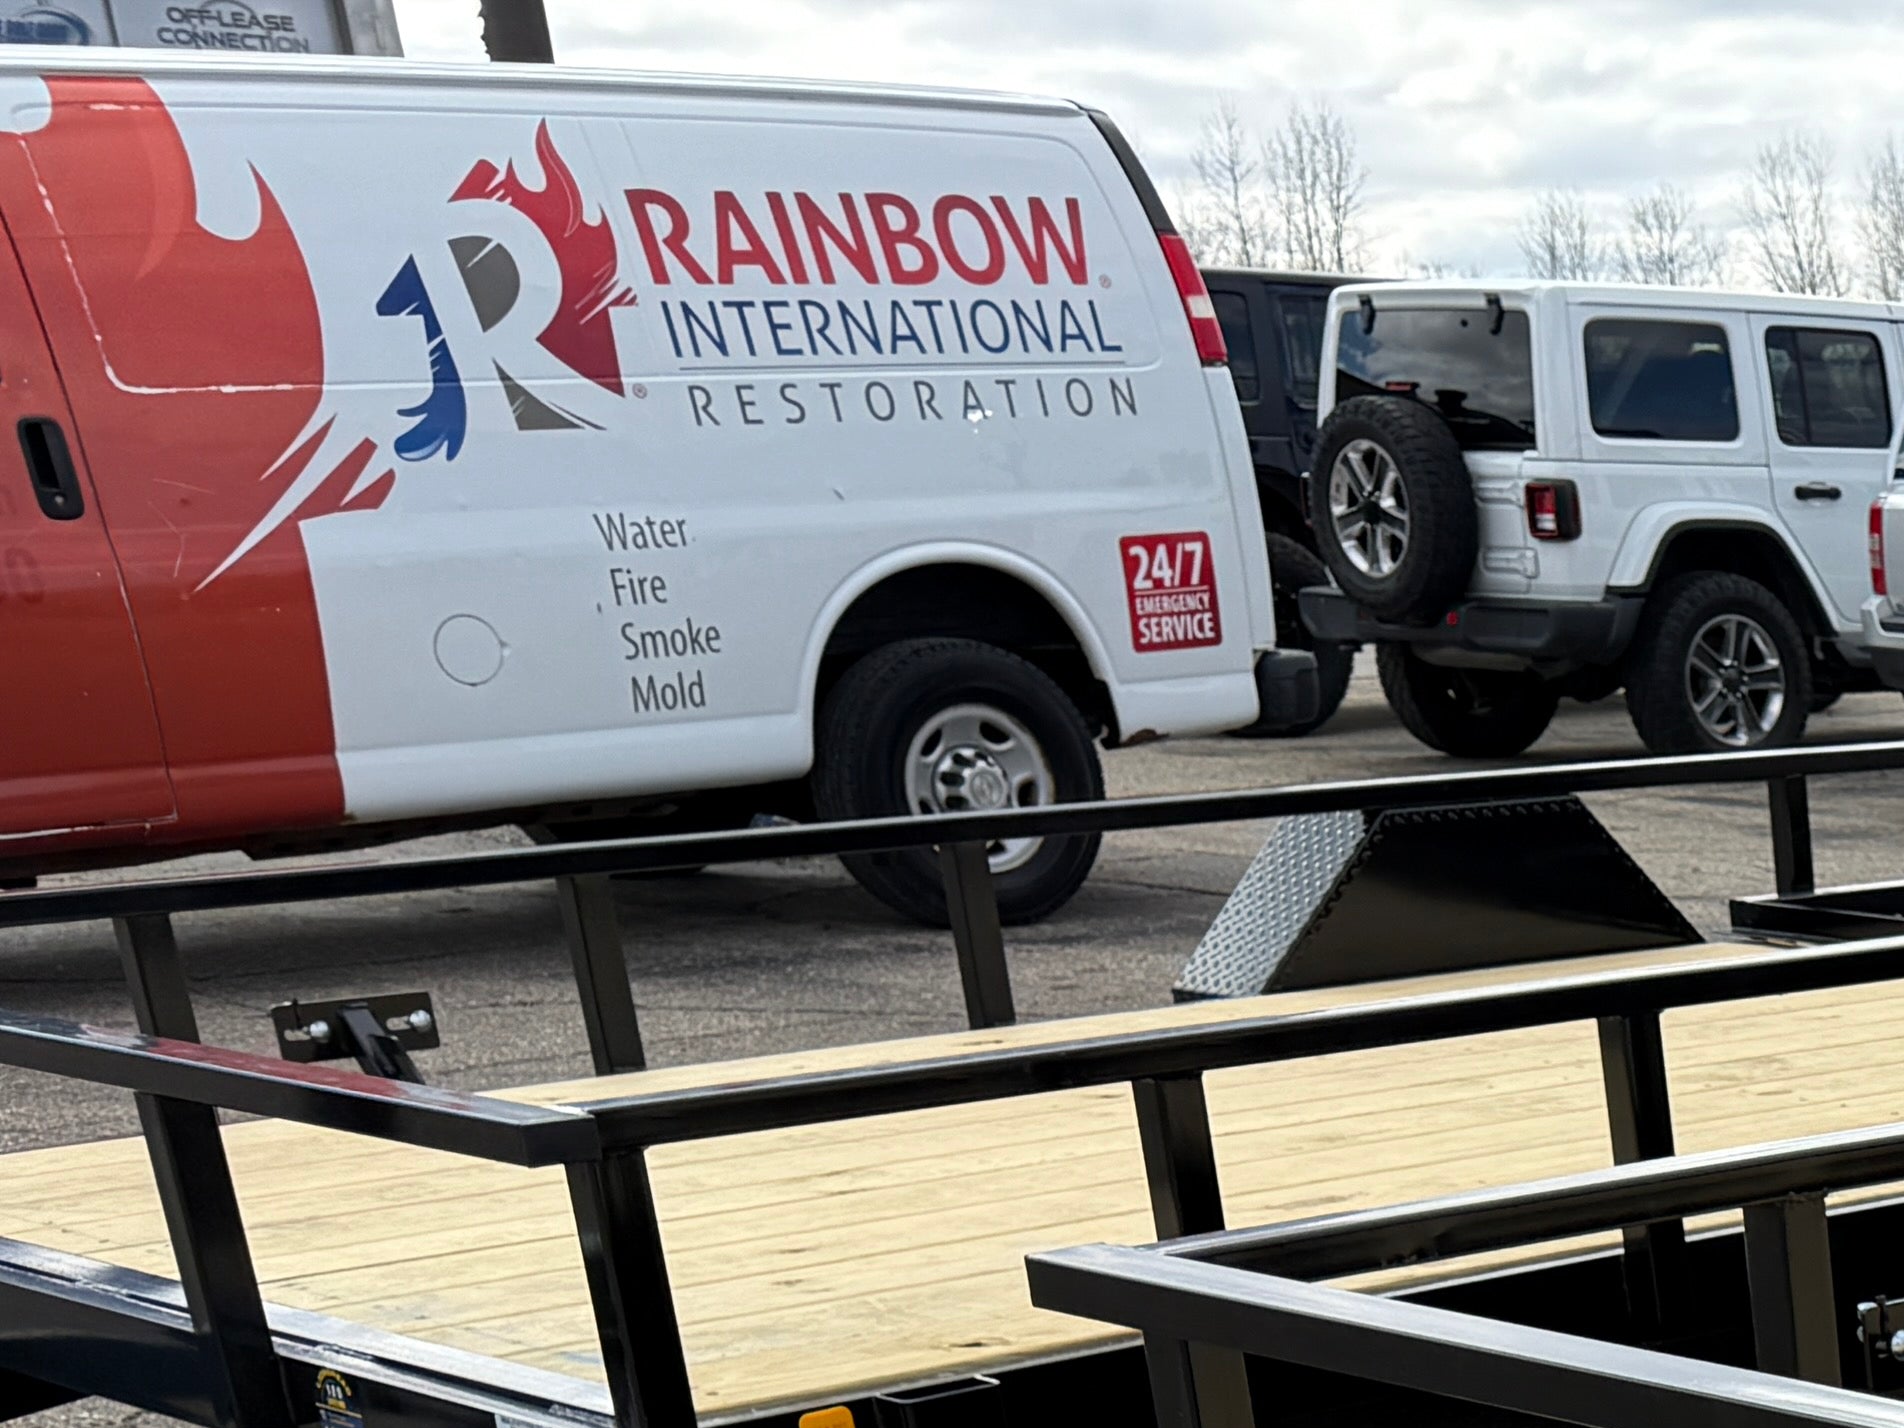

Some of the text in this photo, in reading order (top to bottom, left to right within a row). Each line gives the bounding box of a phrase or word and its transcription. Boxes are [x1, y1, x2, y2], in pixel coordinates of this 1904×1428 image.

[157, 26, 310, 52] CONNECTION
[624, 188, 1089, 286] RAINBOW
[660, 300, 1124, 357] INTERNATIONAL
[688, 376, 1139, 427] RESTORATION
[592, 512, 687, 551] Water
[610, 568, 668, 606] Fire
[1128, 541, 1204, 590] 24/7
[1135, 592, 1210, 615] EMERGENCY
[621, 617, 721, 660] Smoke
[1138, 612, 1216, 644] SERVICE
[631, 669, 706, 713] Mold
